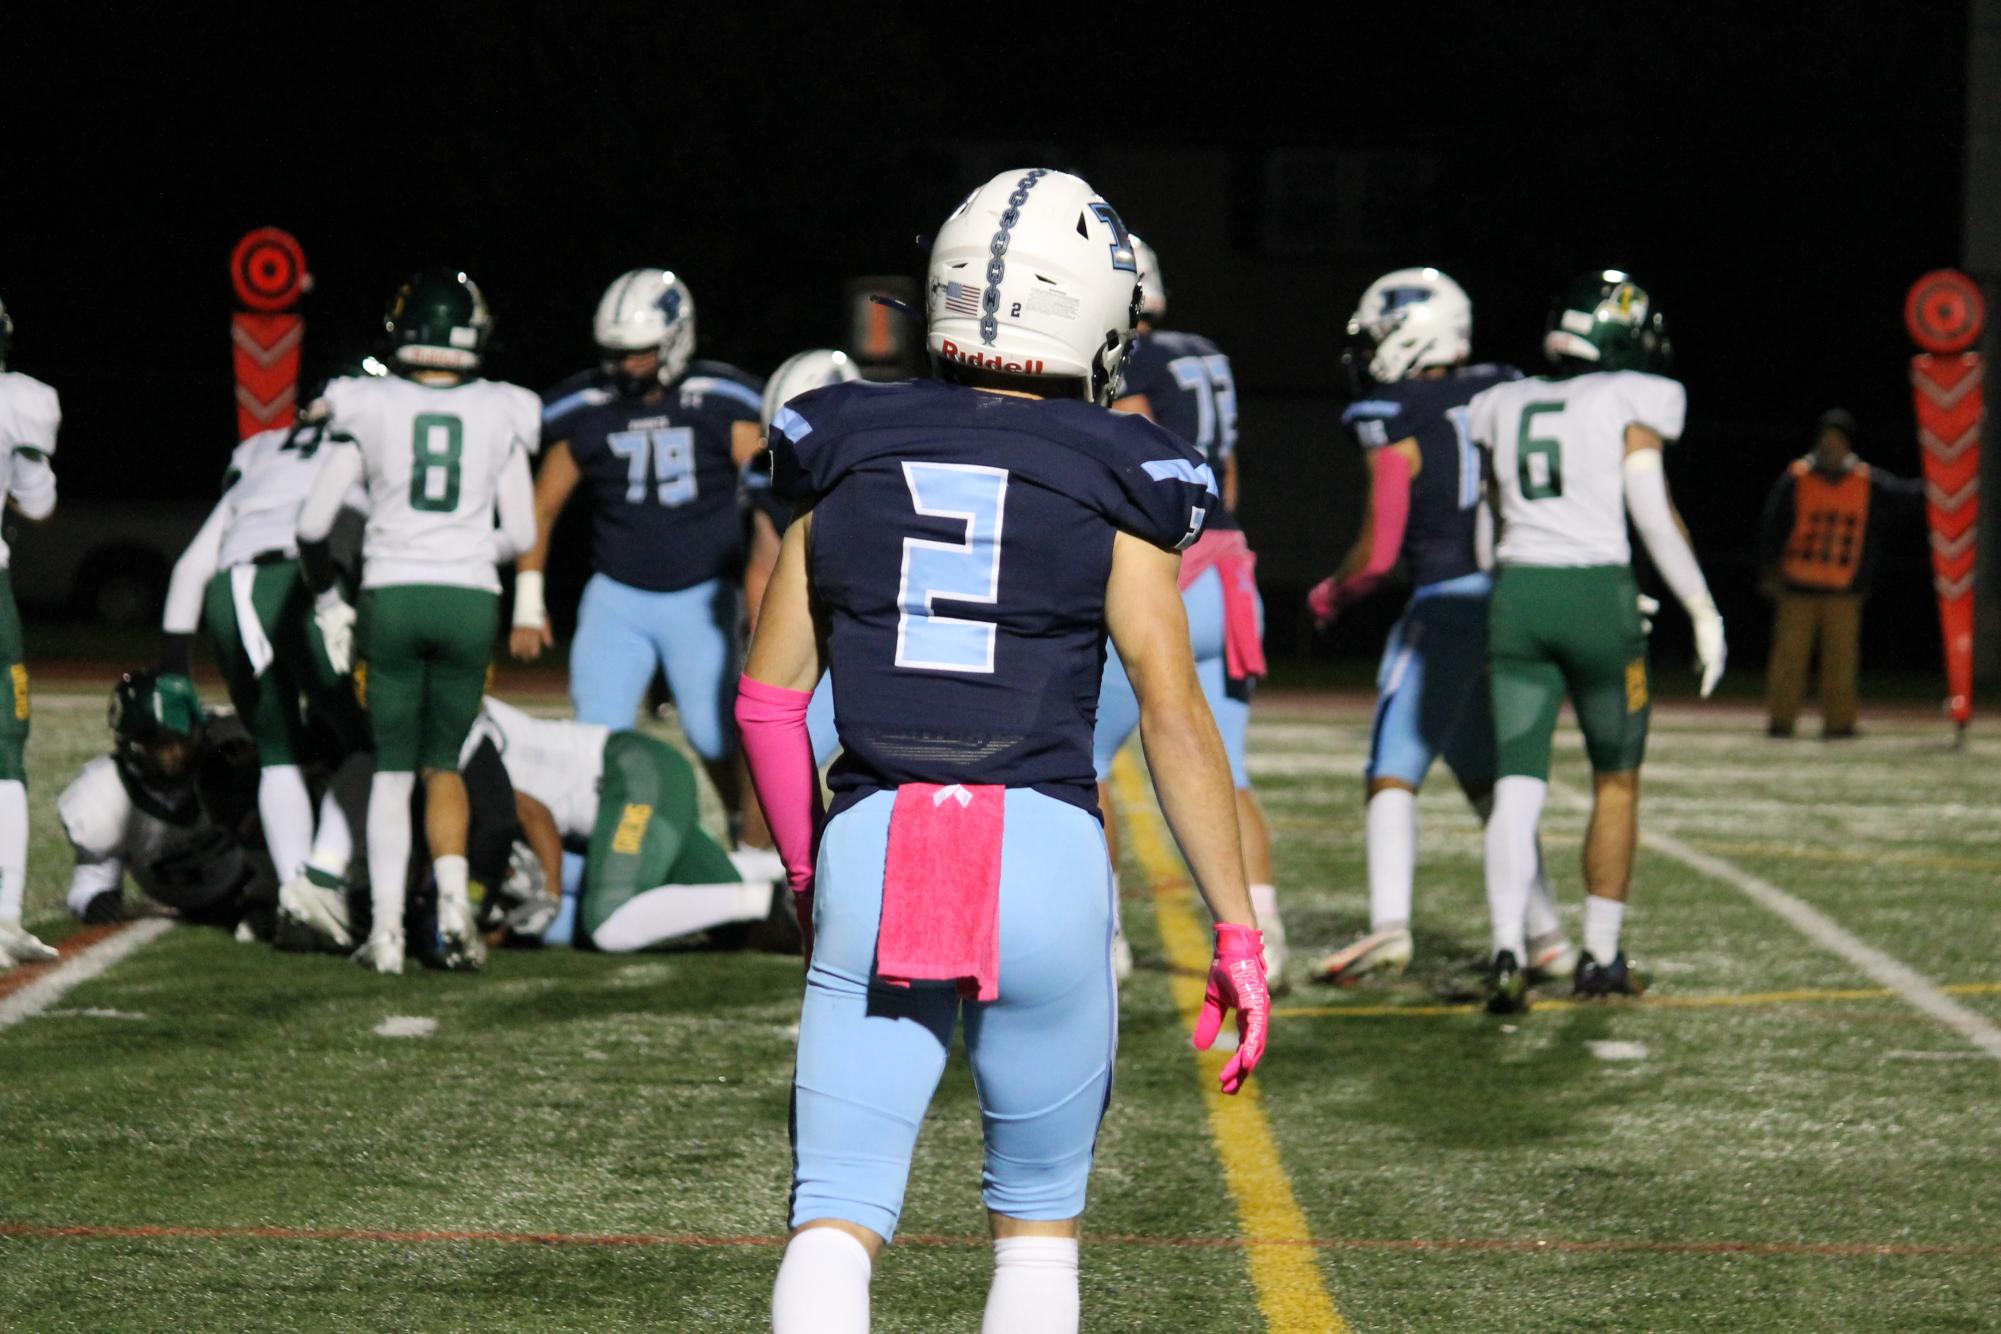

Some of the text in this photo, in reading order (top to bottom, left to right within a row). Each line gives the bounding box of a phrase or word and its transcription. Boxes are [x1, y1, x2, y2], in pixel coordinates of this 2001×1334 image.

[1010, 302, 1022, 318] 2
[942, 338, 1044, 375] Riddell
[410, 411, 463, 513] 8
[607, 427, 698, 506] 79
[1518, 399, 1566, 501] 6
[895, 461, 1009, 674] 2
